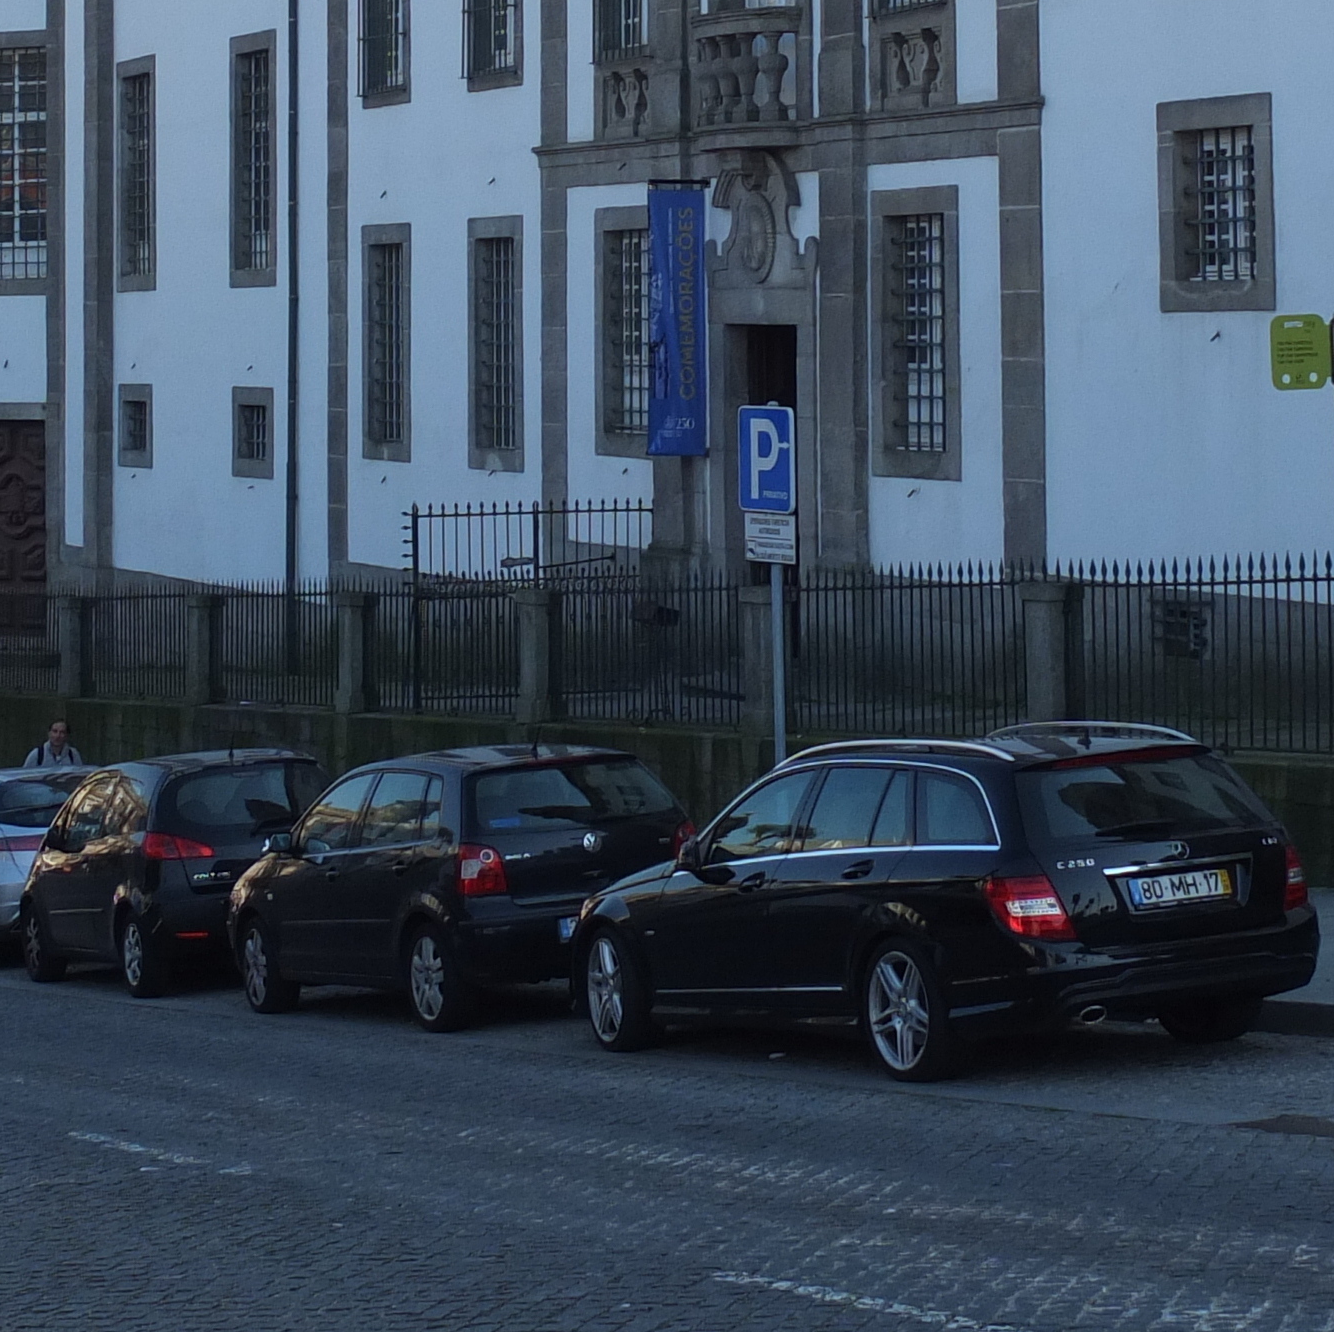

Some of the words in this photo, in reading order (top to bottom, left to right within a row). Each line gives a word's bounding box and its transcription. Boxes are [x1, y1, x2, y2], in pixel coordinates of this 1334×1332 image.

[676, 206, 695, 400] COMEMORAÇÕES
[750, 417, 779, 500] P
[1067, 857, 1096, 868] 250
